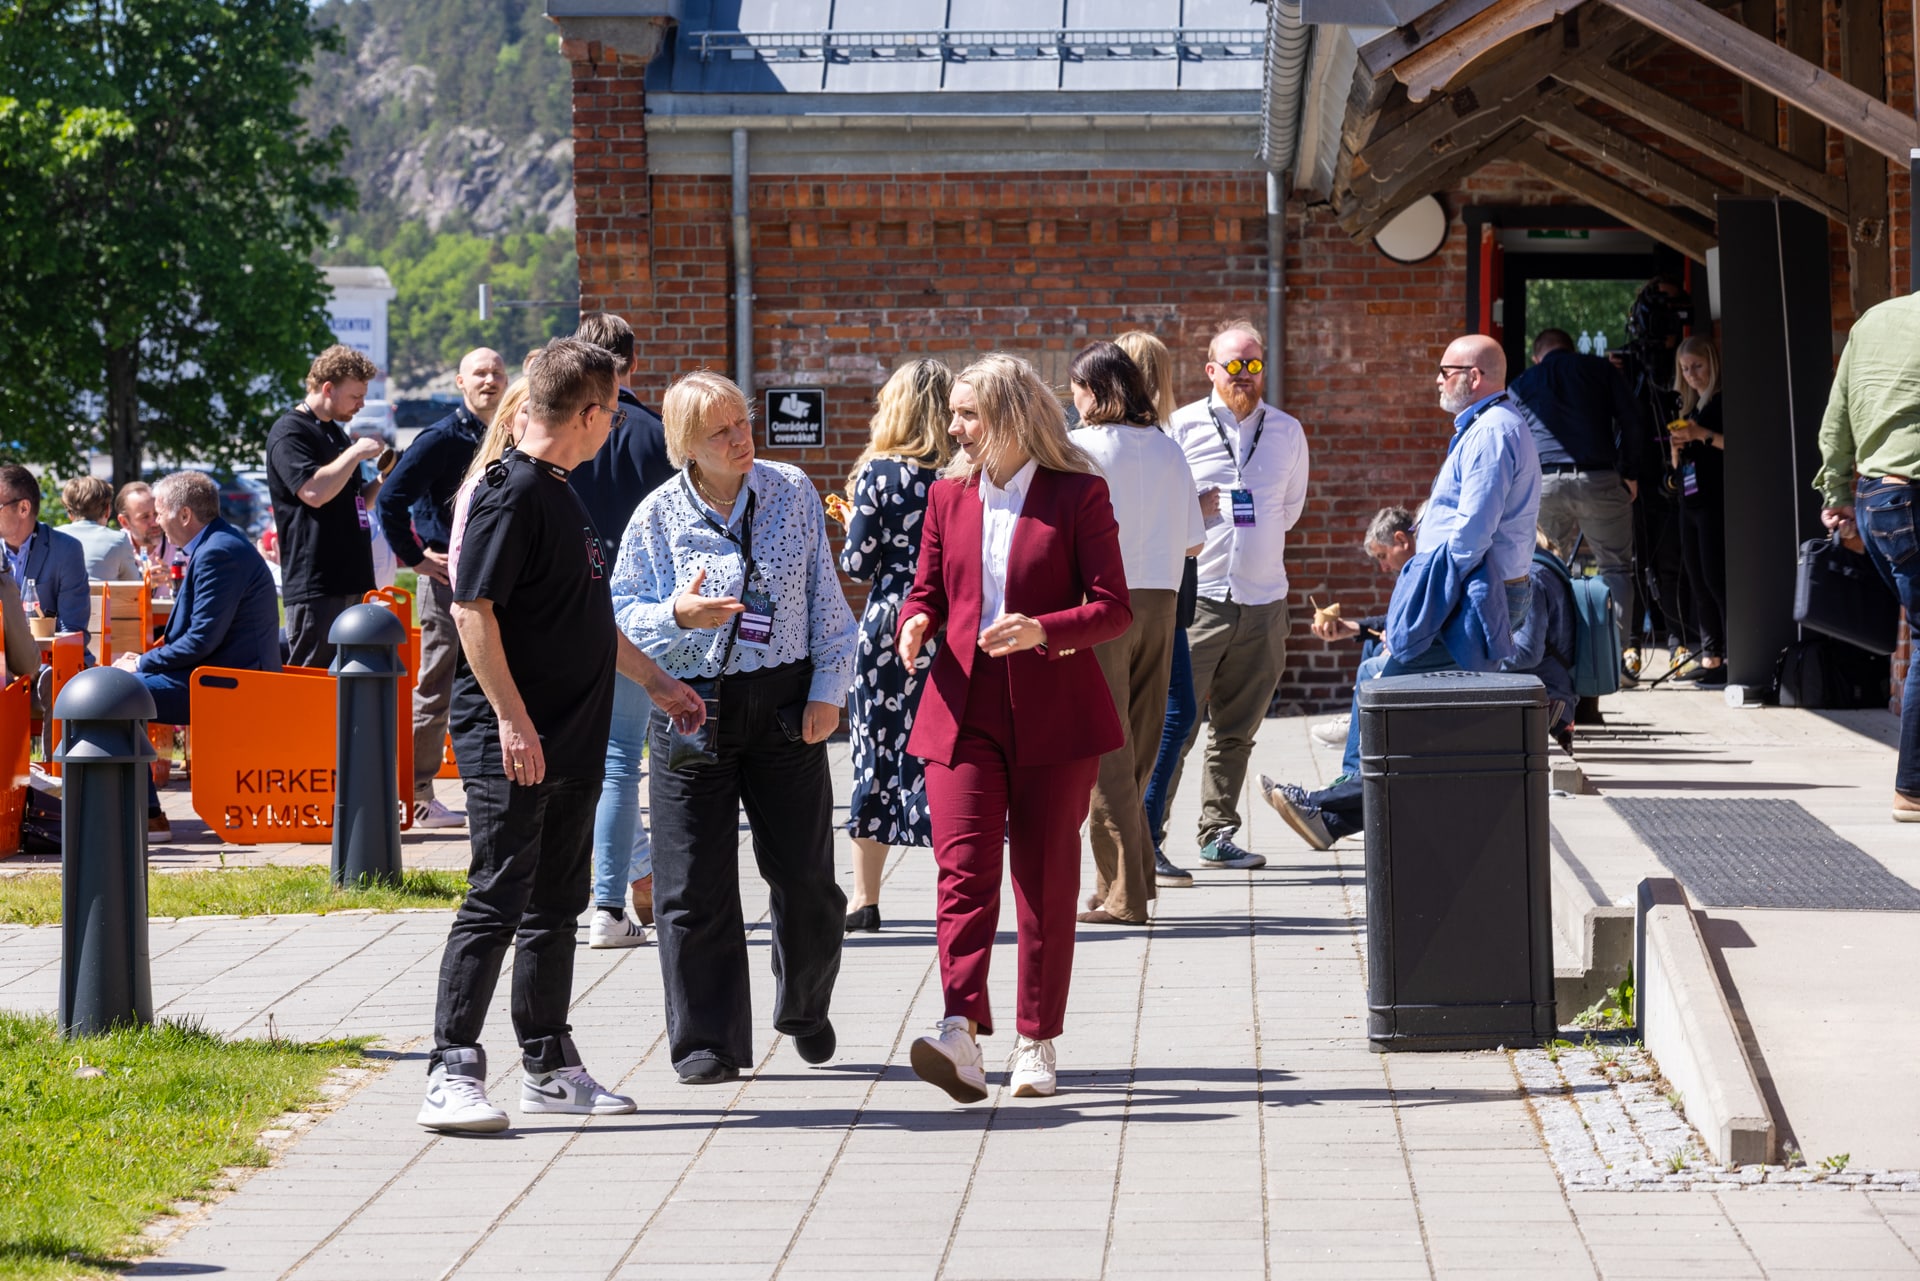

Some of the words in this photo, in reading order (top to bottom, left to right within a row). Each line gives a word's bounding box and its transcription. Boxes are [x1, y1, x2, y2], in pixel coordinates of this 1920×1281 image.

[771, 421, 809, 432] Området
[810, 423, 819, 432] er
[775, 432, 816, 443] overvåket
